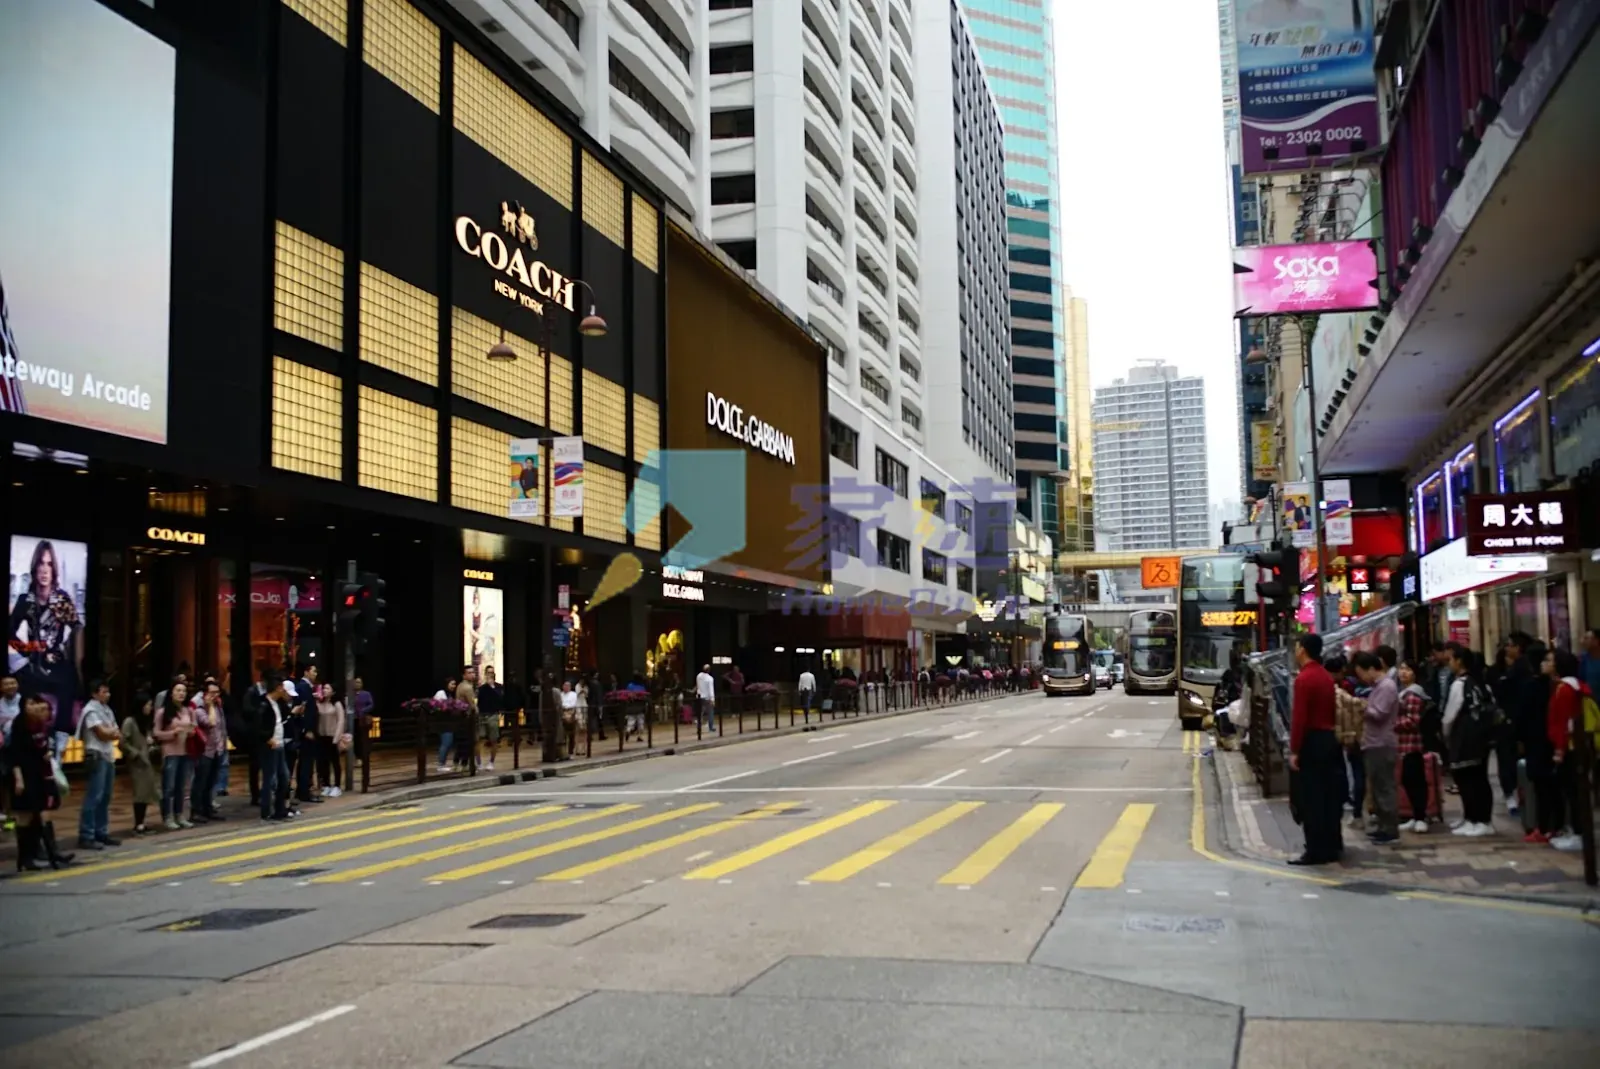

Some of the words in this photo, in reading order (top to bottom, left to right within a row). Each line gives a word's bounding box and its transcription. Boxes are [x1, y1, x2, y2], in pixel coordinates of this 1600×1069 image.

[1287, 130, 1322, 145] 2302
[1326, 126, 1362, 141] 0002
[456, 216, 574, 312] COACH
[494, 279, 517, 301] NEW
[519, 292, 544, 316] YORK
[82, 372, 152, 411] Arcade
[1483, 502, 1563, 527] 周大福
[147, 526, 206, 546] COACH
